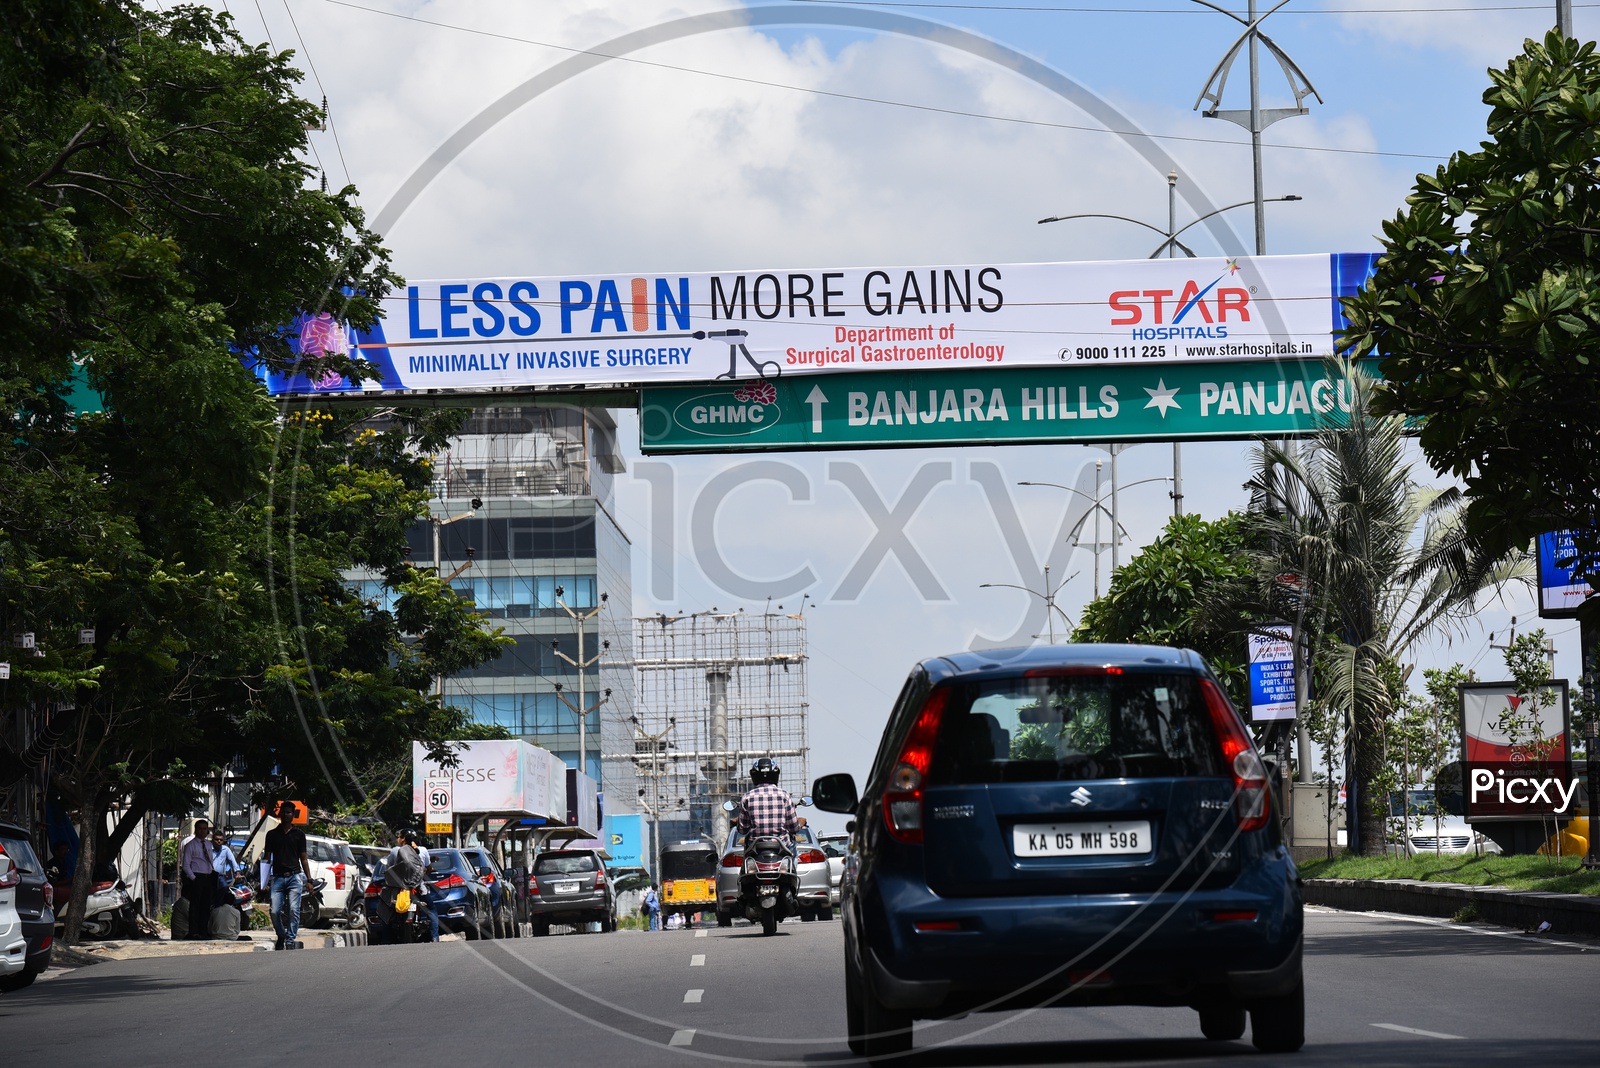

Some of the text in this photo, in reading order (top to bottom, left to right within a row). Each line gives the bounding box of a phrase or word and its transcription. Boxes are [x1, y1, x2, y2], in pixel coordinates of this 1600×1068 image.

[408, 267, 1004, 339] LESS PAIN MORE GAINS
[1108, 280, 1251, 326] STAR
[835, 323, 955, 347] Department of
[1132, 325, 1228, 341] HOSPITALS
[409, 347, 692, 373] MINIMALLY INVASIVE SURGERY
[786, 341, 1005, 367] Surgical Gastroenterology
[1076, 341, 1313, 359] 9000 111 225 www.starhospitals.in
[690, 404, 765, 424] GHMC
[848, 385, 1120, 427] BANJARA HILLS
[1260, 663, 1279, 671] INDIA'S
[1263, 671, 1292, 679] EXHIBITION
[432, 793, 447, 806] 50
[1028, 832, 1138, 850] KA 05 MH 598
